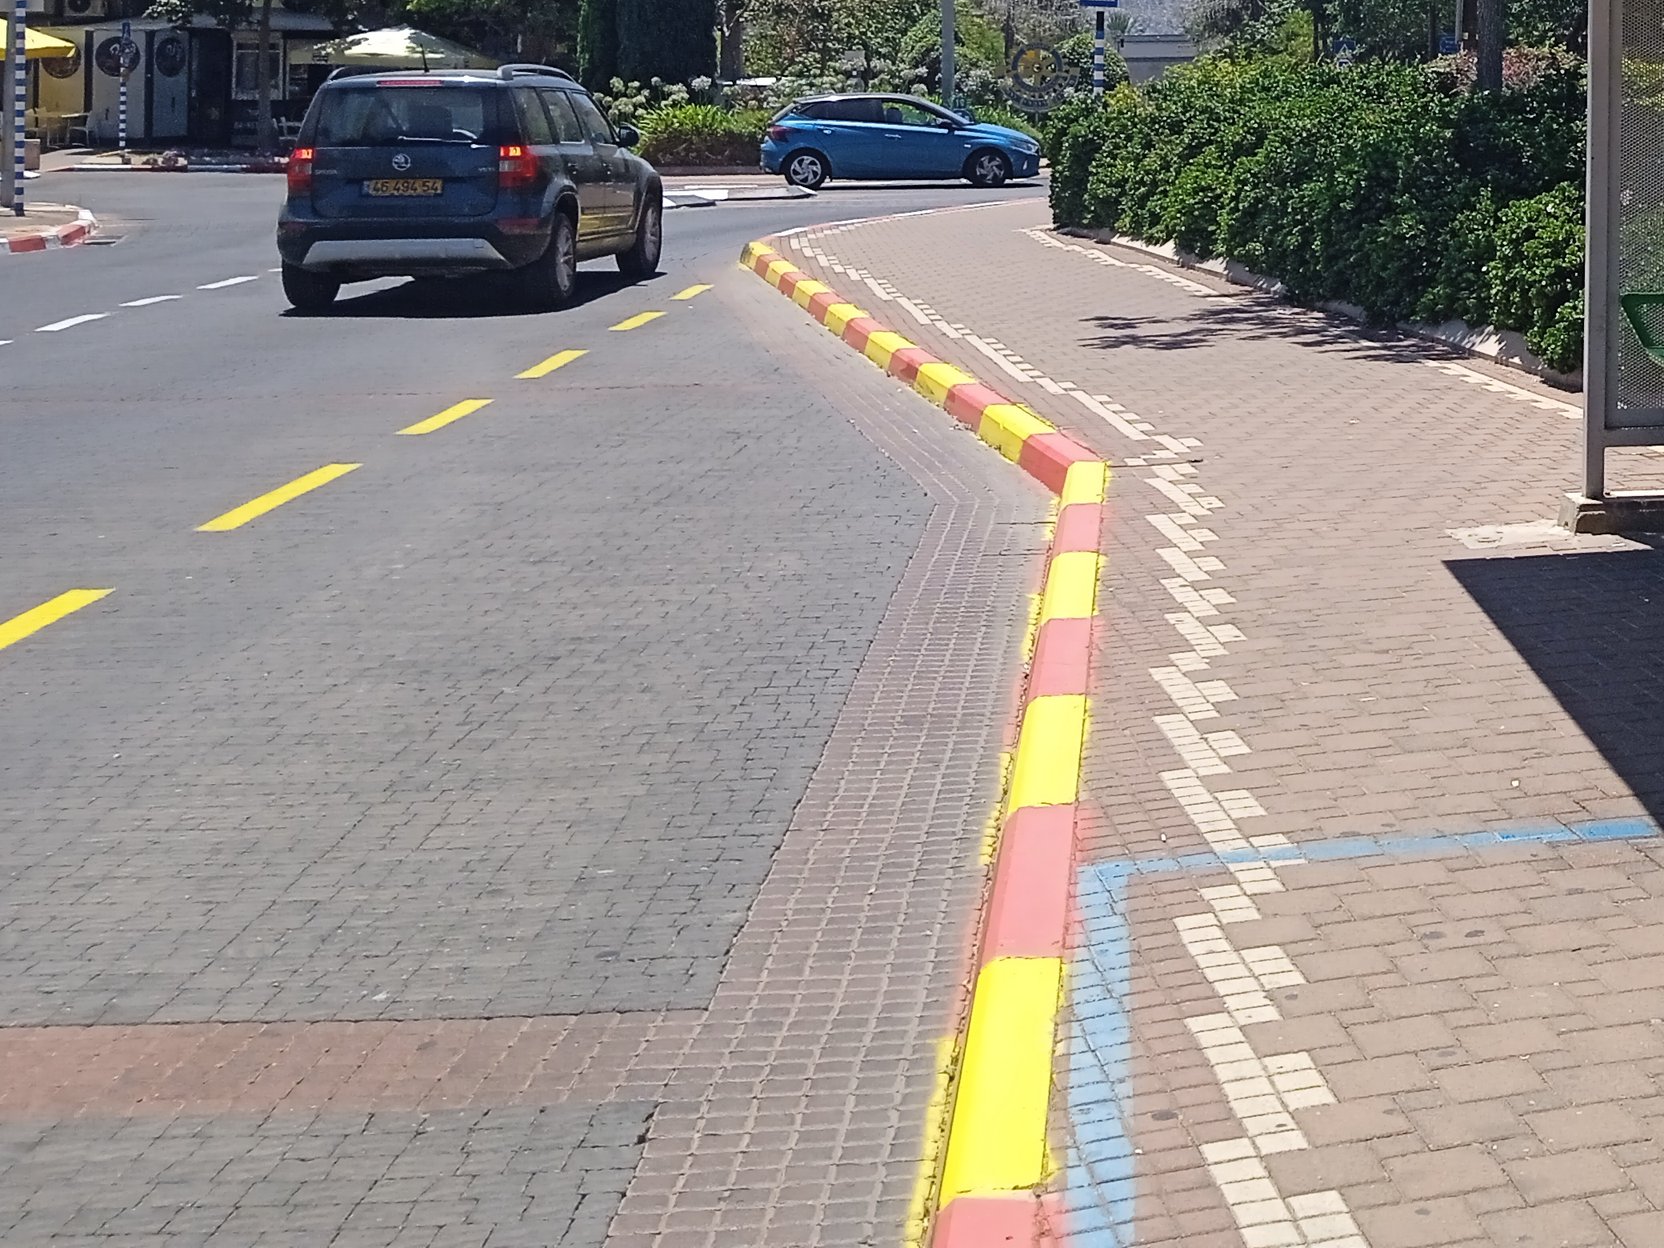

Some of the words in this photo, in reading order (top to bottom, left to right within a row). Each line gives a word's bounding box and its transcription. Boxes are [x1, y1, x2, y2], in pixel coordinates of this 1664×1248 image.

[373, 181, 389, 193] 46
[393, 181, 418, 193] 494
[422, 180, 440, 193] 54
